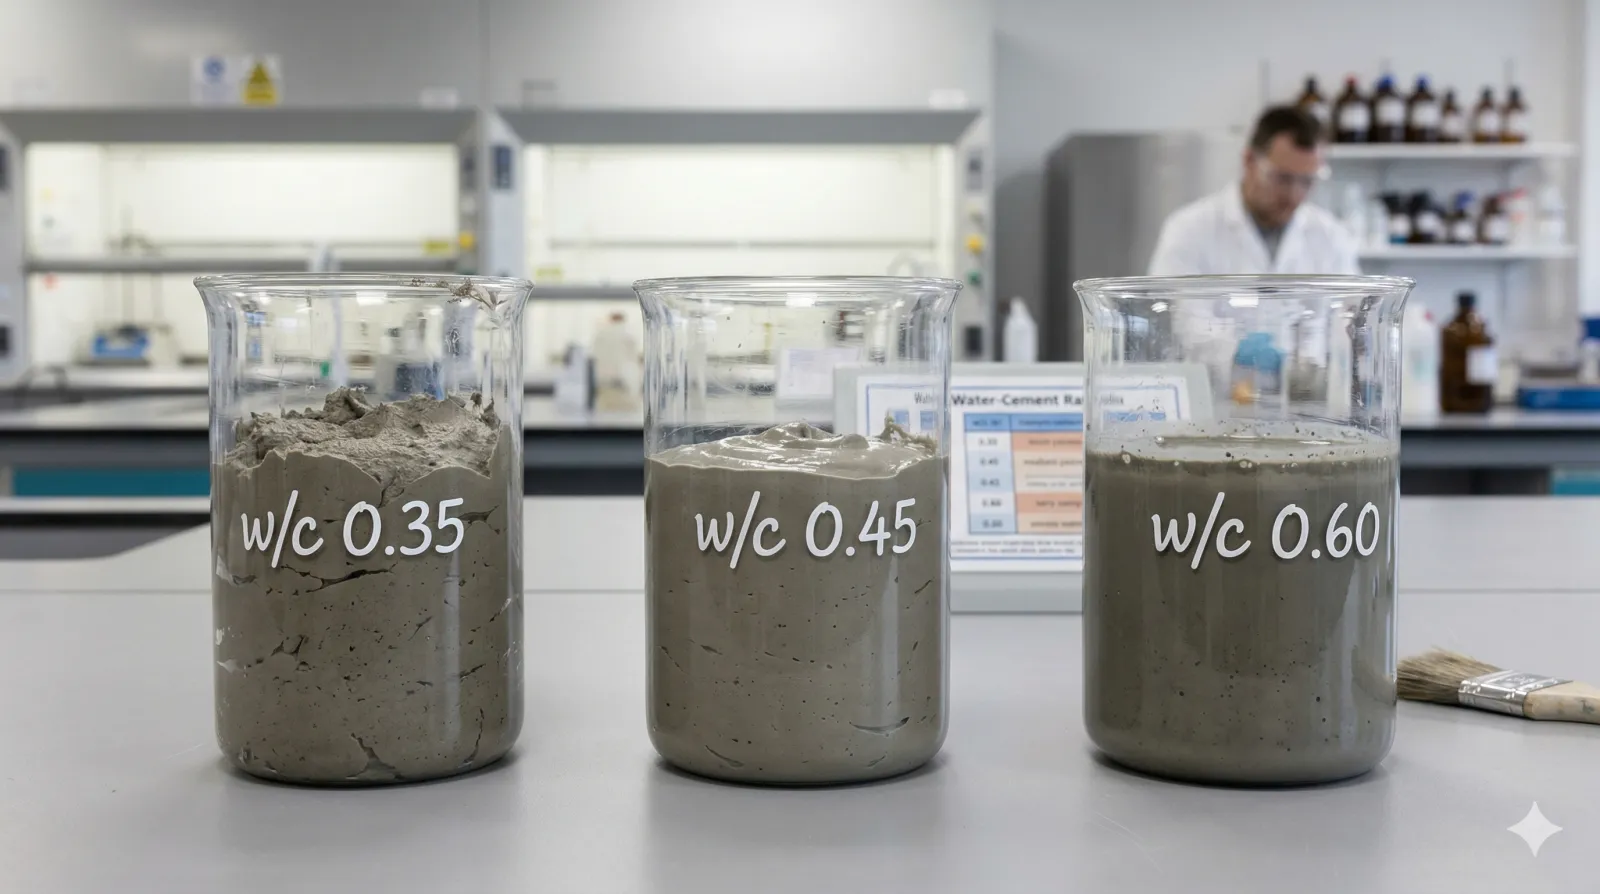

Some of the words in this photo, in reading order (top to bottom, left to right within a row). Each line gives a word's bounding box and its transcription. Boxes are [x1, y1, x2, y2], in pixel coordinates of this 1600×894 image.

[951, 393, 1059, 406] Water-Cement
[1064, 393, 1084, 406] Ra
[241, 489, 324, 568] w/c
[343, 497, 465, 557] 0.35
[694, 490, 786, 569] w/c
[805, 497, 918, 557] 0.45
[1151, 491, 1252, 569] w/c
[1271, 501, 1381, 559] 0.60
